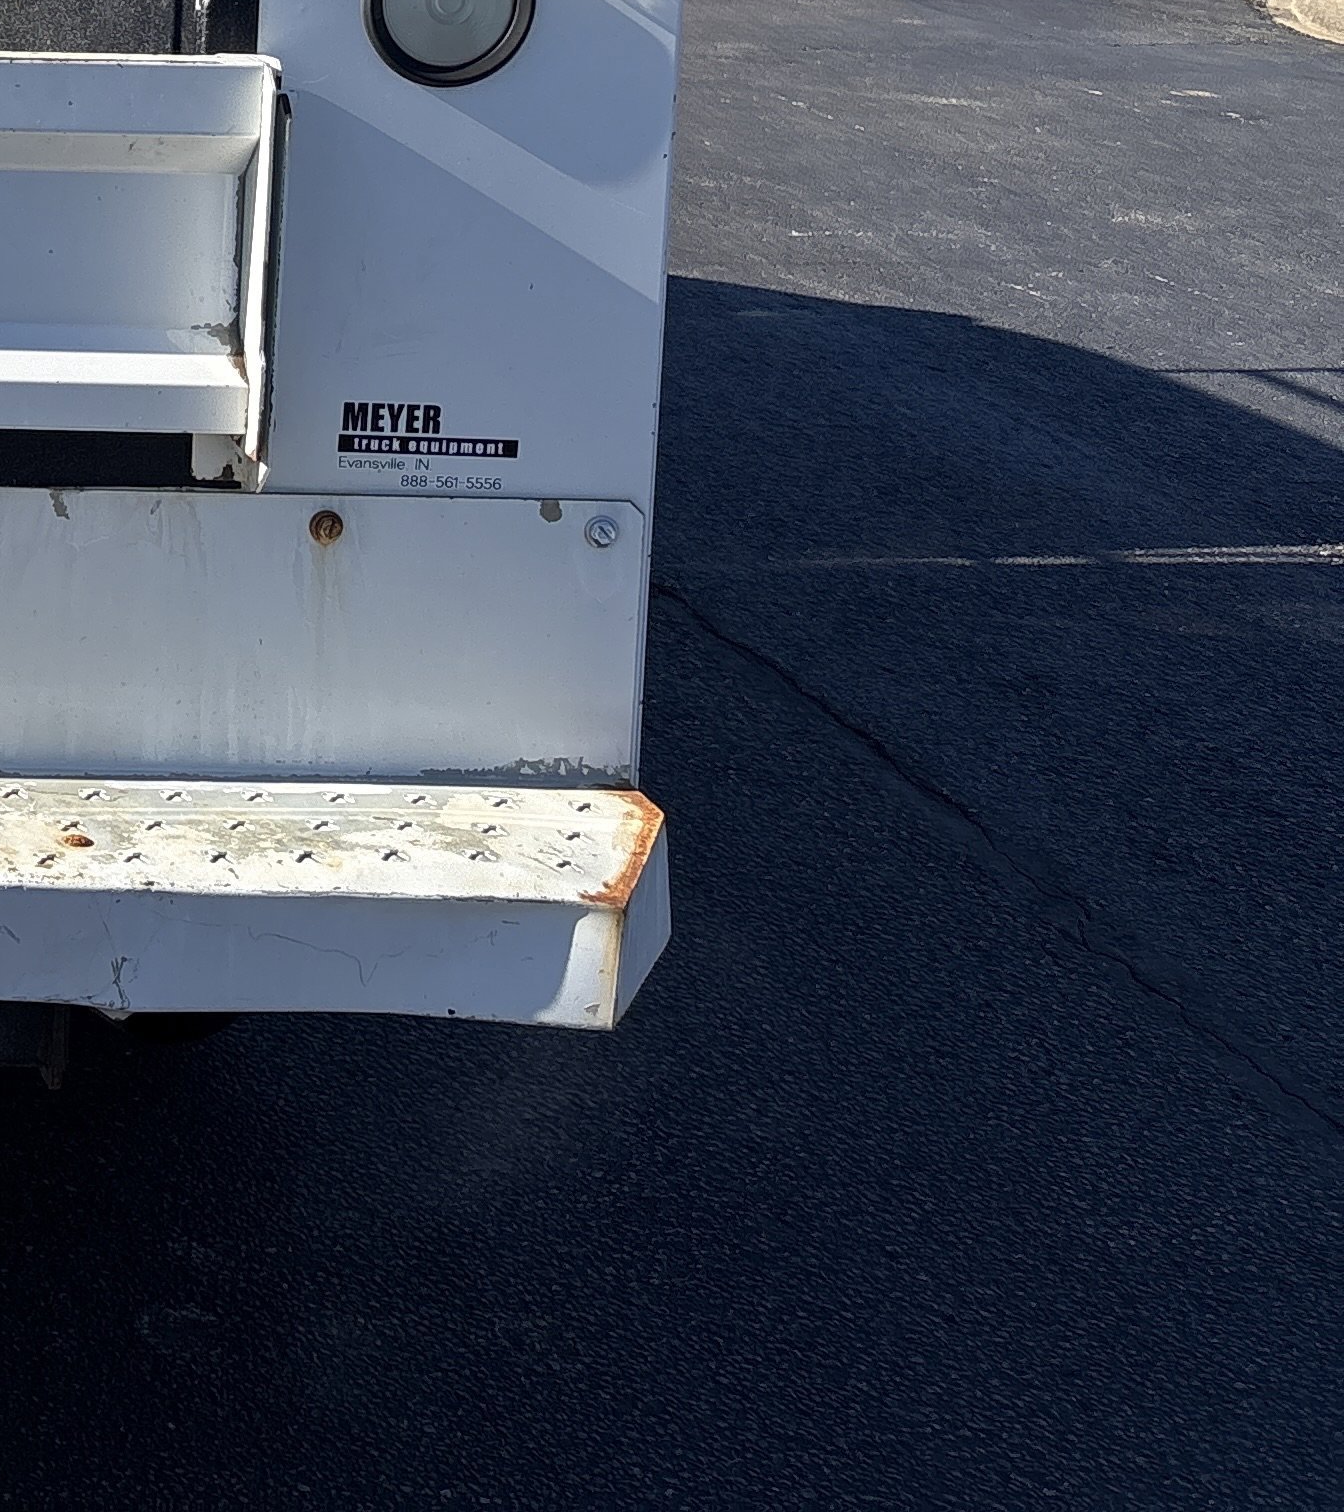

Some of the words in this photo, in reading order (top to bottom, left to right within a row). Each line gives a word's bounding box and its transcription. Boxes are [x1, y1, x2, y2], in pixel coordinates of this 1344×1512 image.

[341, 401, 442, 434] MEYER
[353, 437, 401, 452] truck
[408, 439, 504, 455] equipment
[400, 474, 502, 490] 888-561-5556
